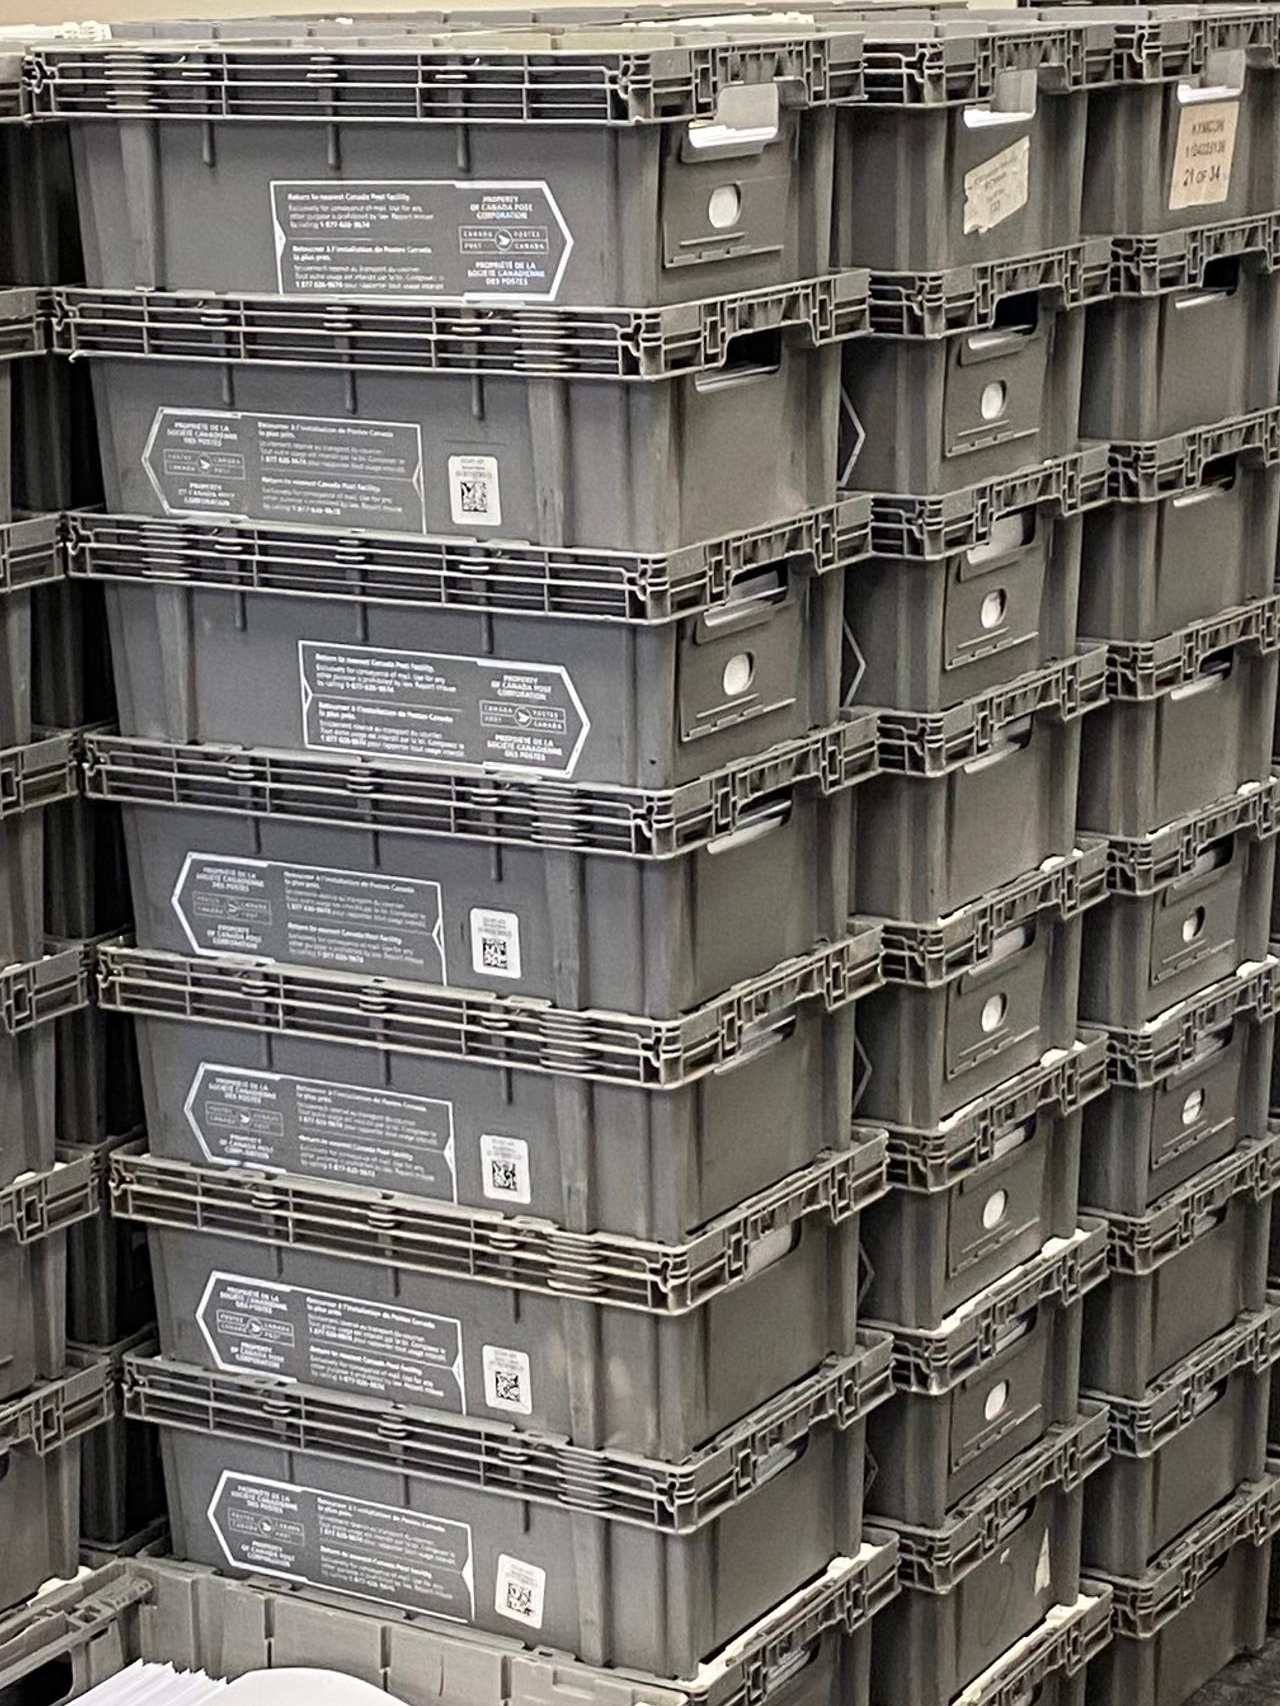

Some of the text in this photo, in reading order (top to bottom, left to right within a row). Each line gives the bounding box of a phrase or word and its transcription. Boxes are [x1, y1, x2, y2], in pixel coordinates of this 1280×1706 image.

[476, 211, 527, 219] CORPORATION
[475, 260, 512, 268] PROPRIÉTÉ
[467, 269, 545, 277] SOCIÉTÉ CANADIENNE
[485, 277, 528, 285] DES POSTES
